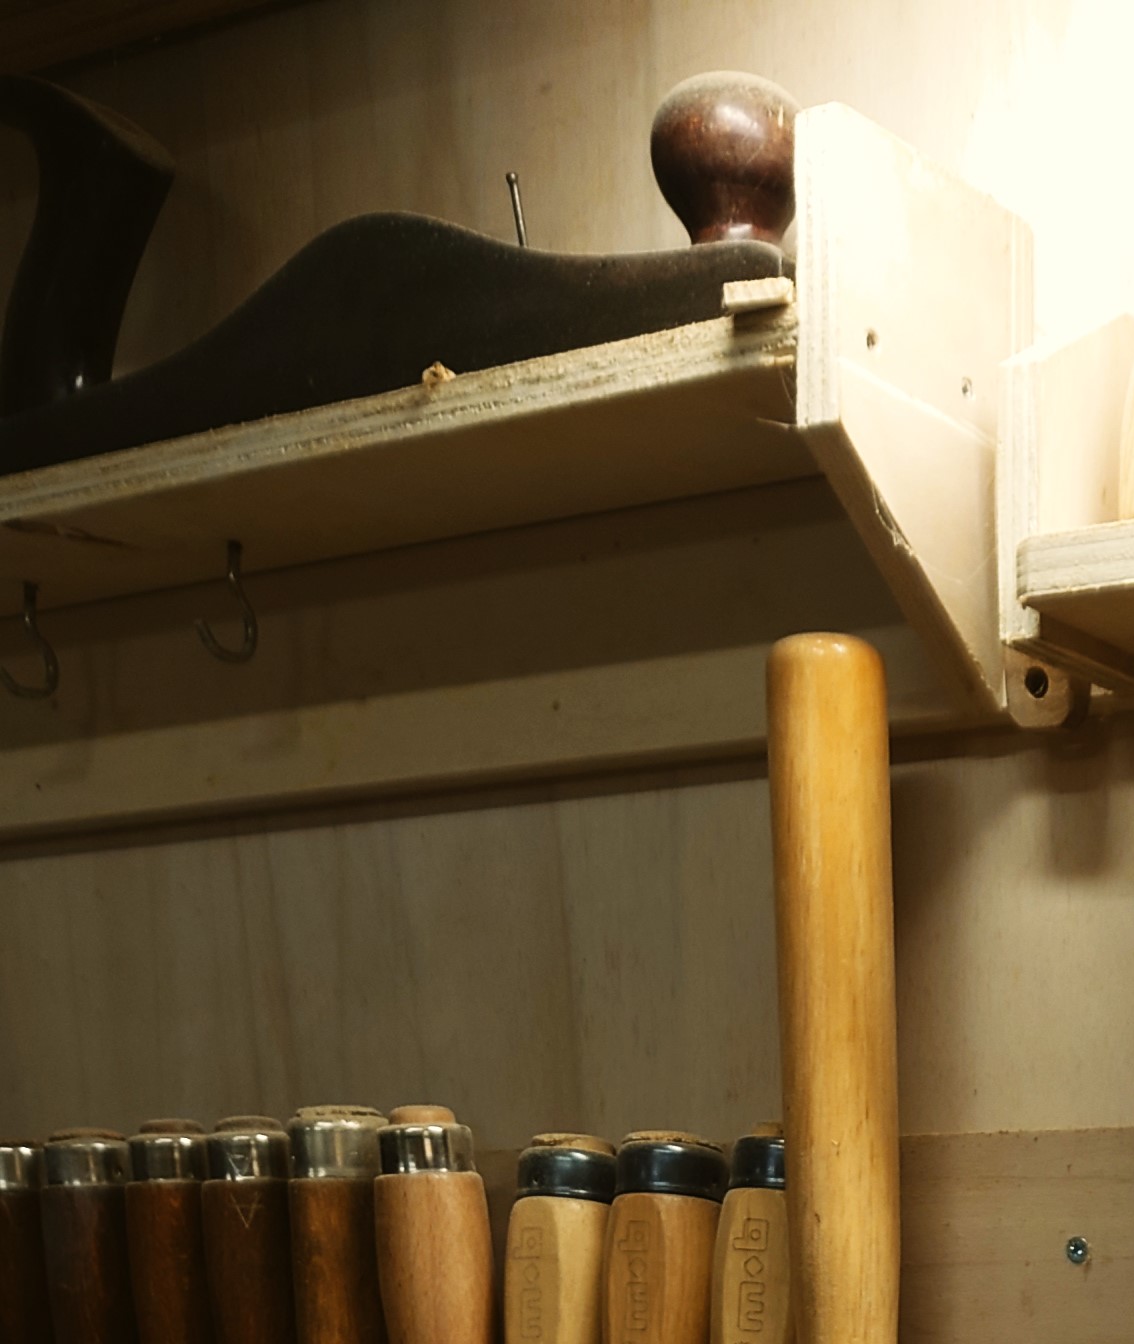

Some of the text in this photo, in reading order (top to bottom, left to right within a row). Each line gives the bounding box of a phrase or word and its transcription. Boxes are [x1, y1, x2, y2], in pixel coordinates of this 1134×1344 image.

[514, 1227, 543, 1338] mob
[618, 1220, 650, 1331] mob
[732, 1217, 769, 1332] mob
